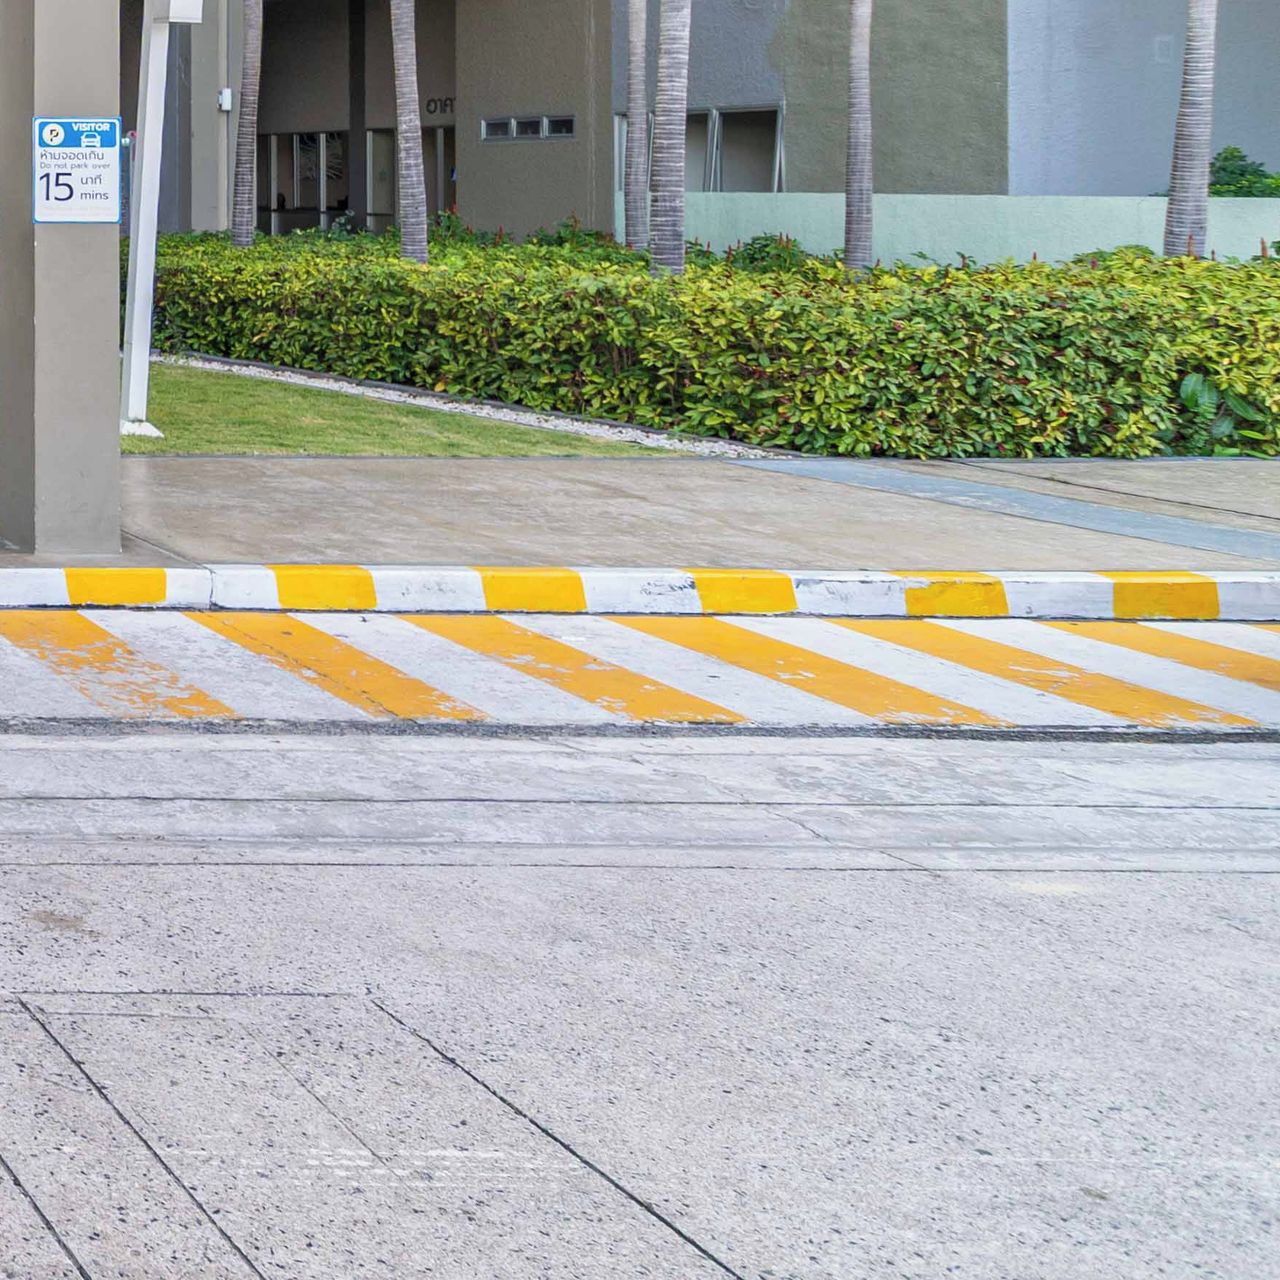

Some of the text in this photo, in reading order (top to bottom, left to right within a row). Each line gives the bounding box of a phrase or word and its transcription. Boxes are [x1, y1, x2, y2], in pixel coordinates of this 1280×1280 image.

[426, 96, 456, 114] อาค
[72, 122, 110, 132] VISITOR
[40, 149, 104, 161] ห้ามจอดเกิน
[40, 162, 51, 170] Do
[71, 162, 88, 170] park
[81, 174, 102, 185] นาที
[39, 172, 74, 201] 15
[80, 190, 109, 200] mins
